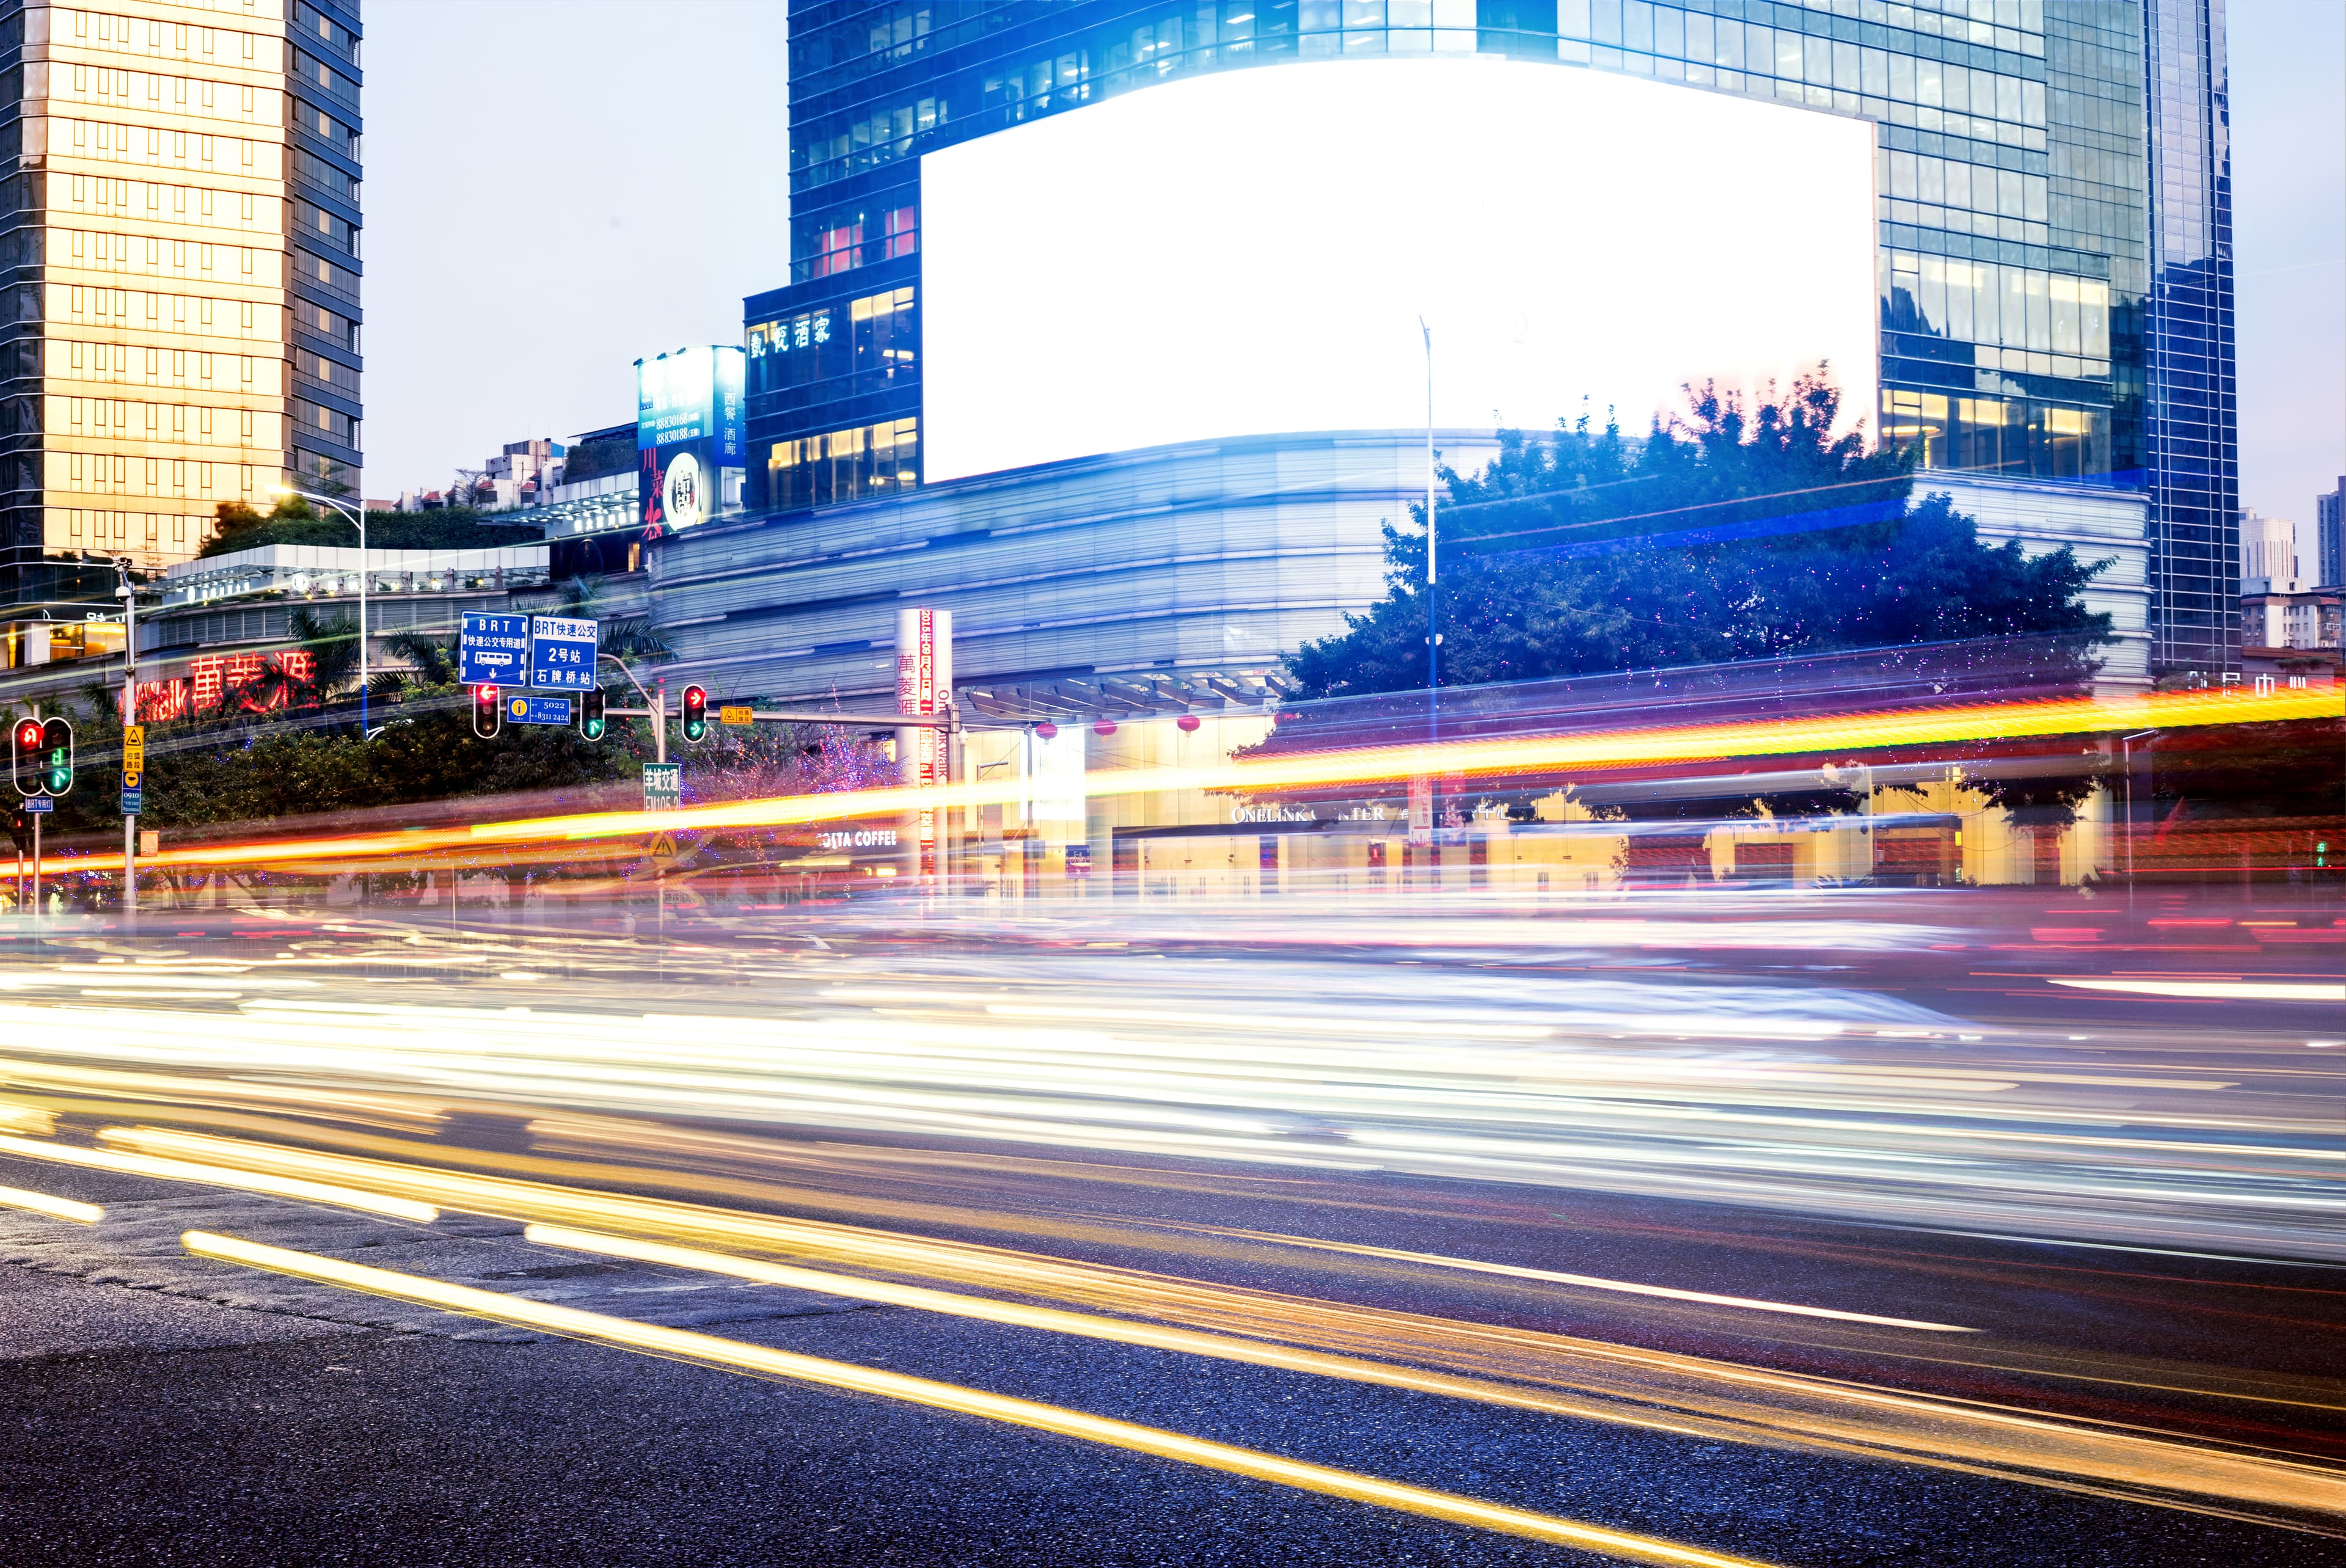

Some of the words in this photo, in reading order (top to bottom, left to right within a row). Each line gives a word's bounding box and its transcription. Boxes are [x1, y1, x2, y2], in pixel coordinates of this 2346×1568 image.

[479, 619, 510, 632] BRT
[535, 620, 596, 638] BRT快速公交
[467, 635, 521, 649] 快速公交专用道
[549, 647, 580, 663] 2号站
[537, 669, 590, 685] 石牌桥站
[645, 768, 678, 792] 羊城交通
[646, 795, 679, 813] FM1052
[855, 830, 897, 847] COFFEE
